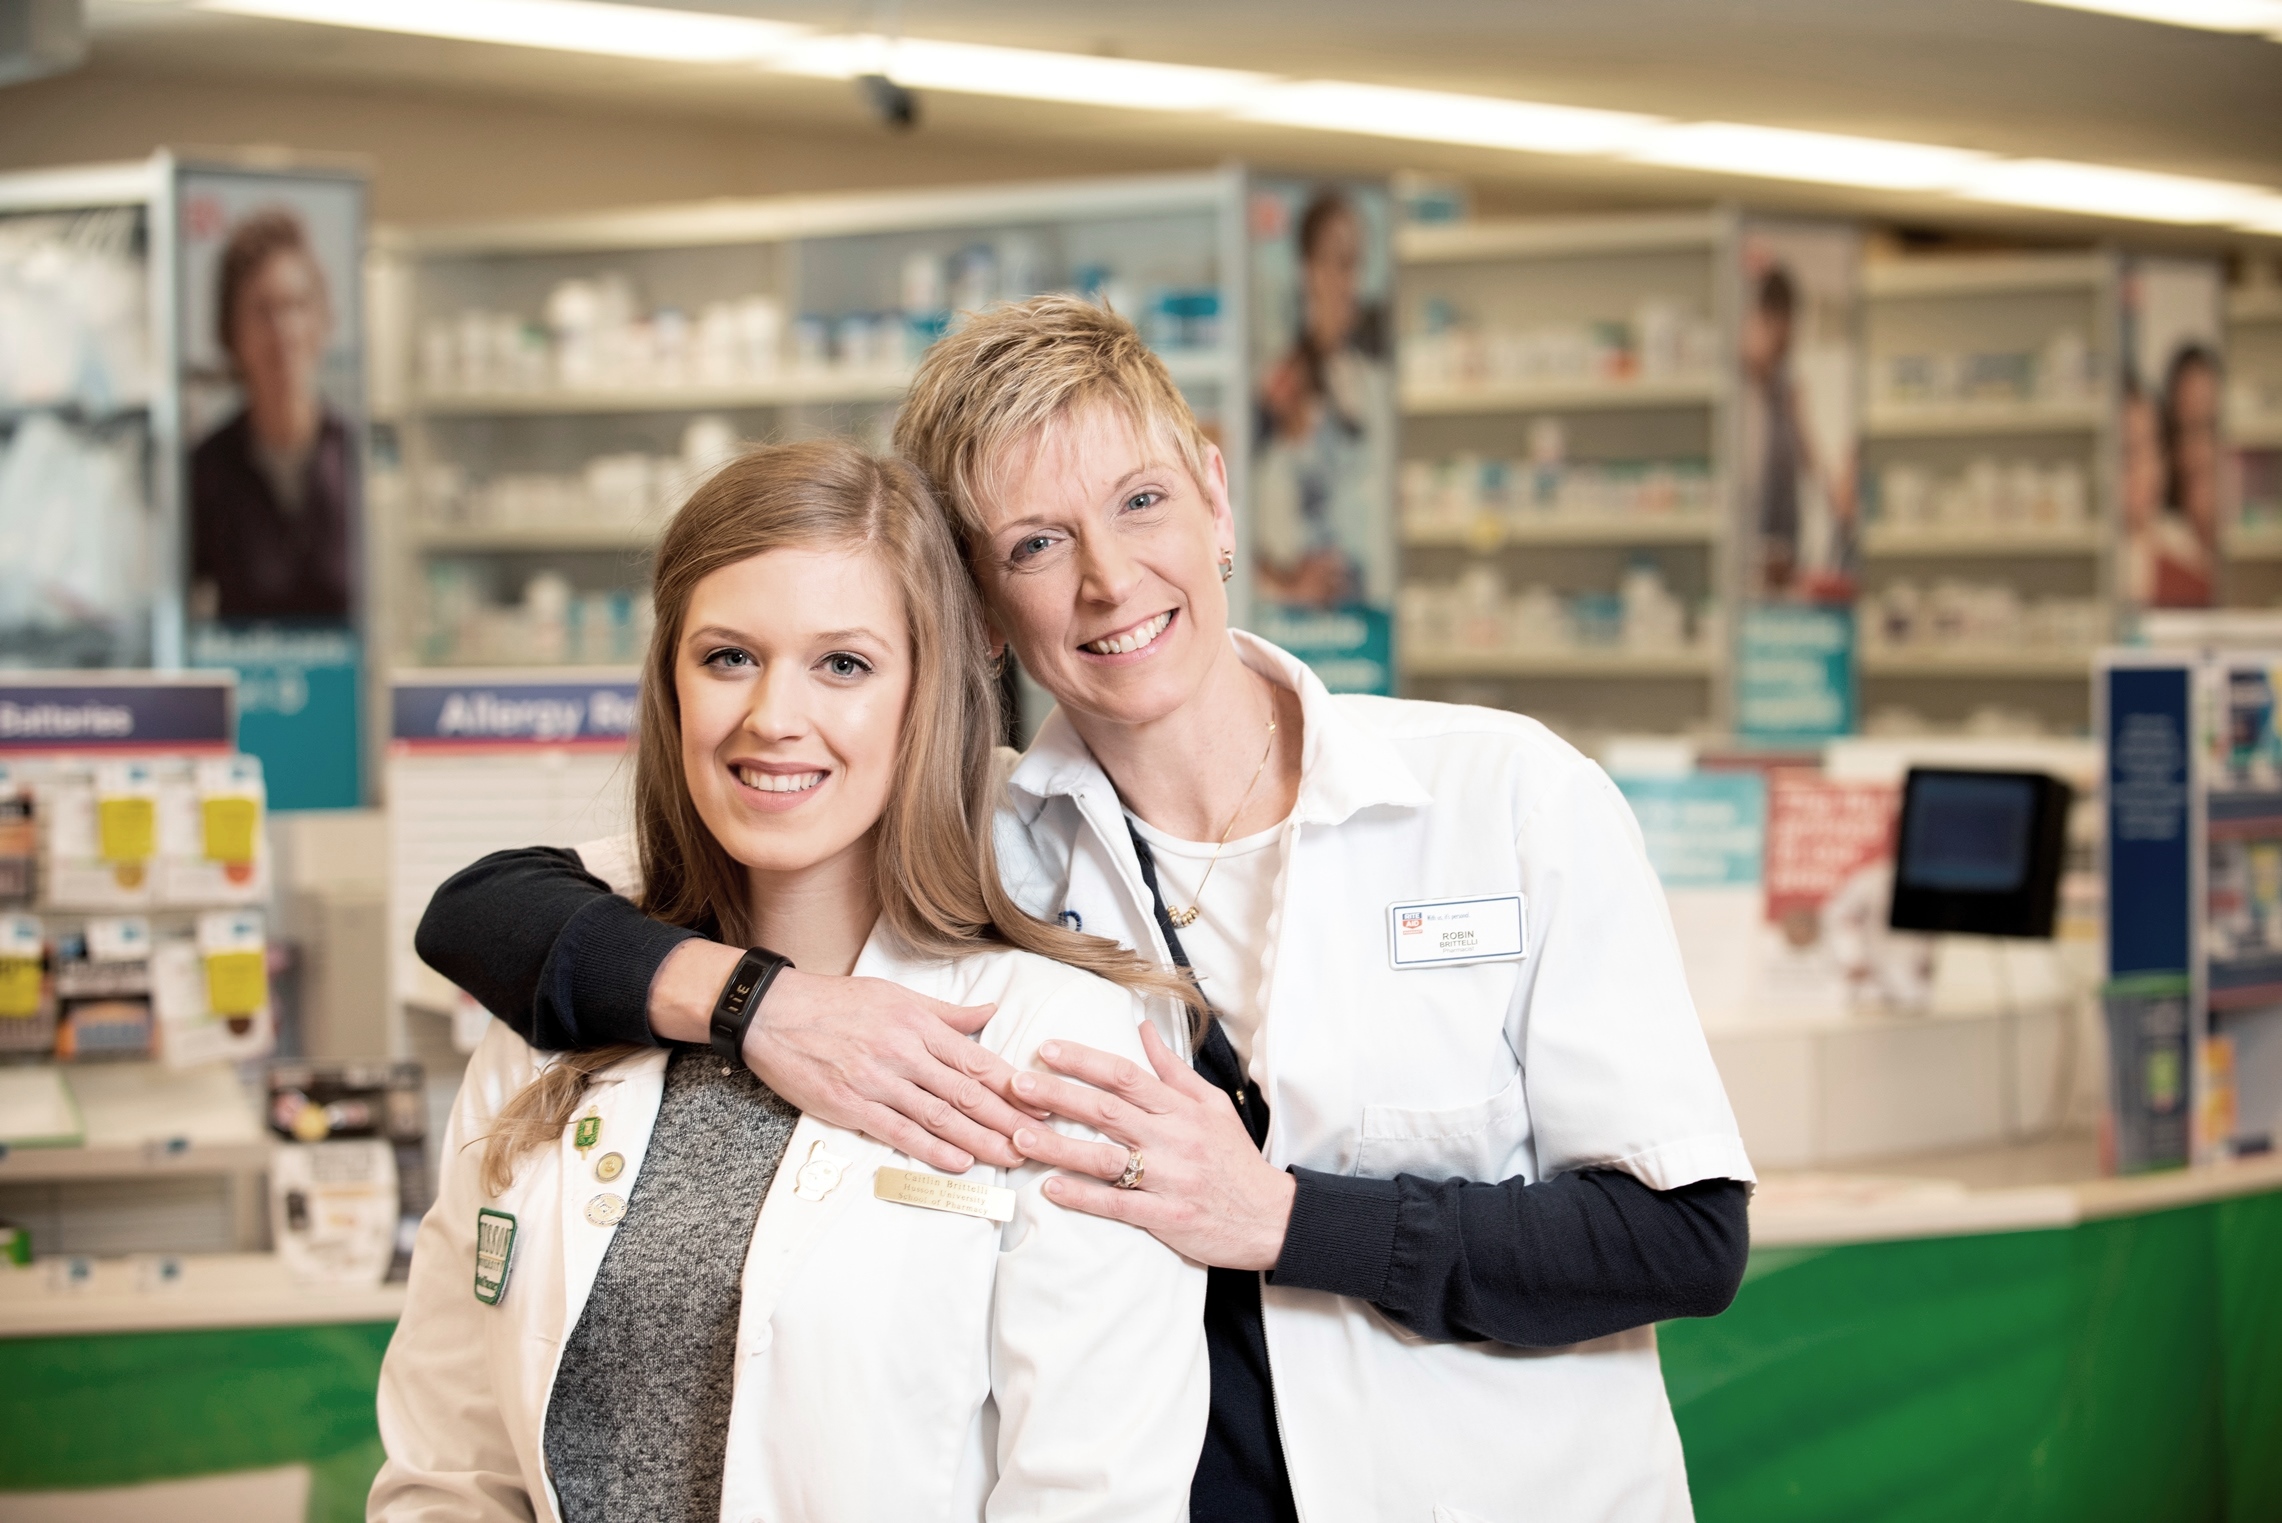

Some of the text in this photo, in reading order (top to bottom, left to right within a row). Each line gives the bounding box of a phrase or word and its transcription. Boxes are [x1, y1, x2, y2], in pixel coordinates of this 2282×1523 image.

[0, 701, 134, 737] Batteries
[439, 692, 584, 740] Allergy
[1439, 939, 1478, 948] BRITTELLI
[1442, 930, 1474, 940] ROBIN
[903, 1183, 986, 1206] Husson University
[904, 1172, 988, 1194] Caitlin Brittelli
[898, 1192, 927, 1204] School
[945, 1200, 988, 1216] Pharmacy
